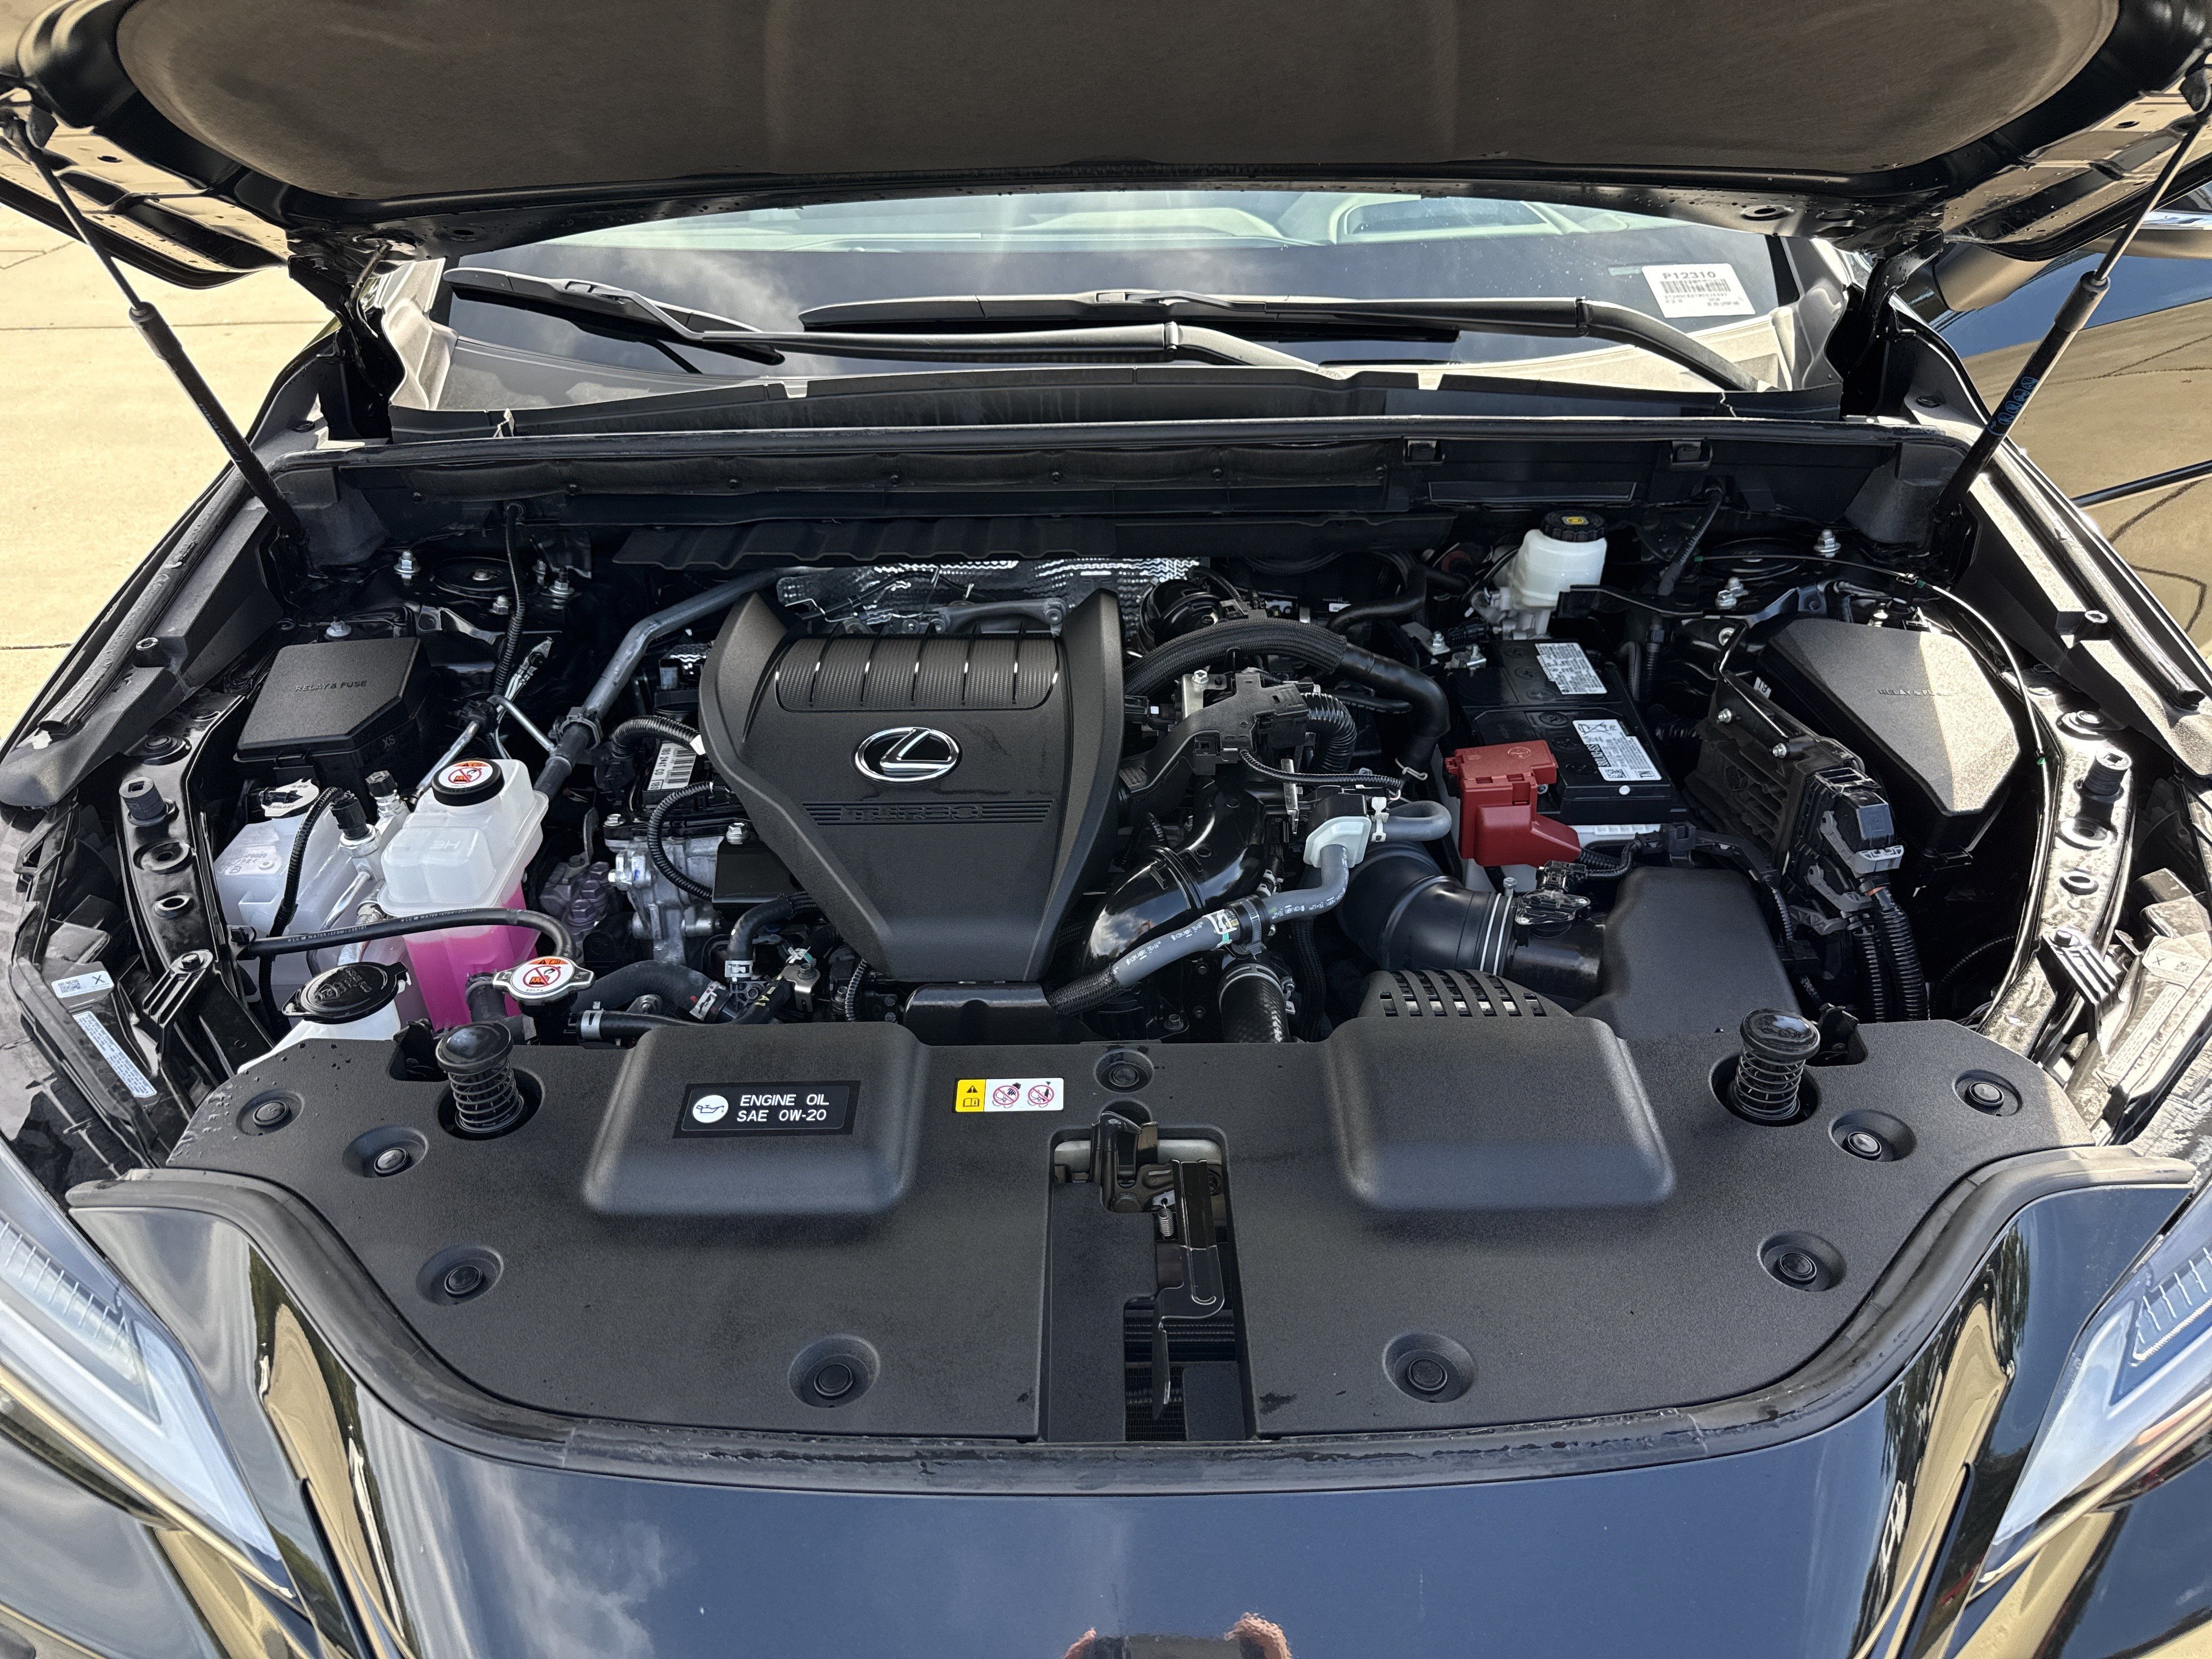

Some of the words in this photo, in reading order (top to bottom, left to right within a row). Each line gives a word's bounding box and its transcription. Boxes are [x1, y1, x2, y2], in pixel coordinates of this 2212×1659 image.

[1662, 271, 1716, 279] P12310
[295, 684, 330, 692] RELAY
[340, 680, 368, 689] FUSE
[740, 1094, 797, 1106] ENGINE
[806, 1094, 830, 1105] OIL
[737, 1110, 769, 1122] SAE
[779, 1109, 827, 1121] 0W-20
